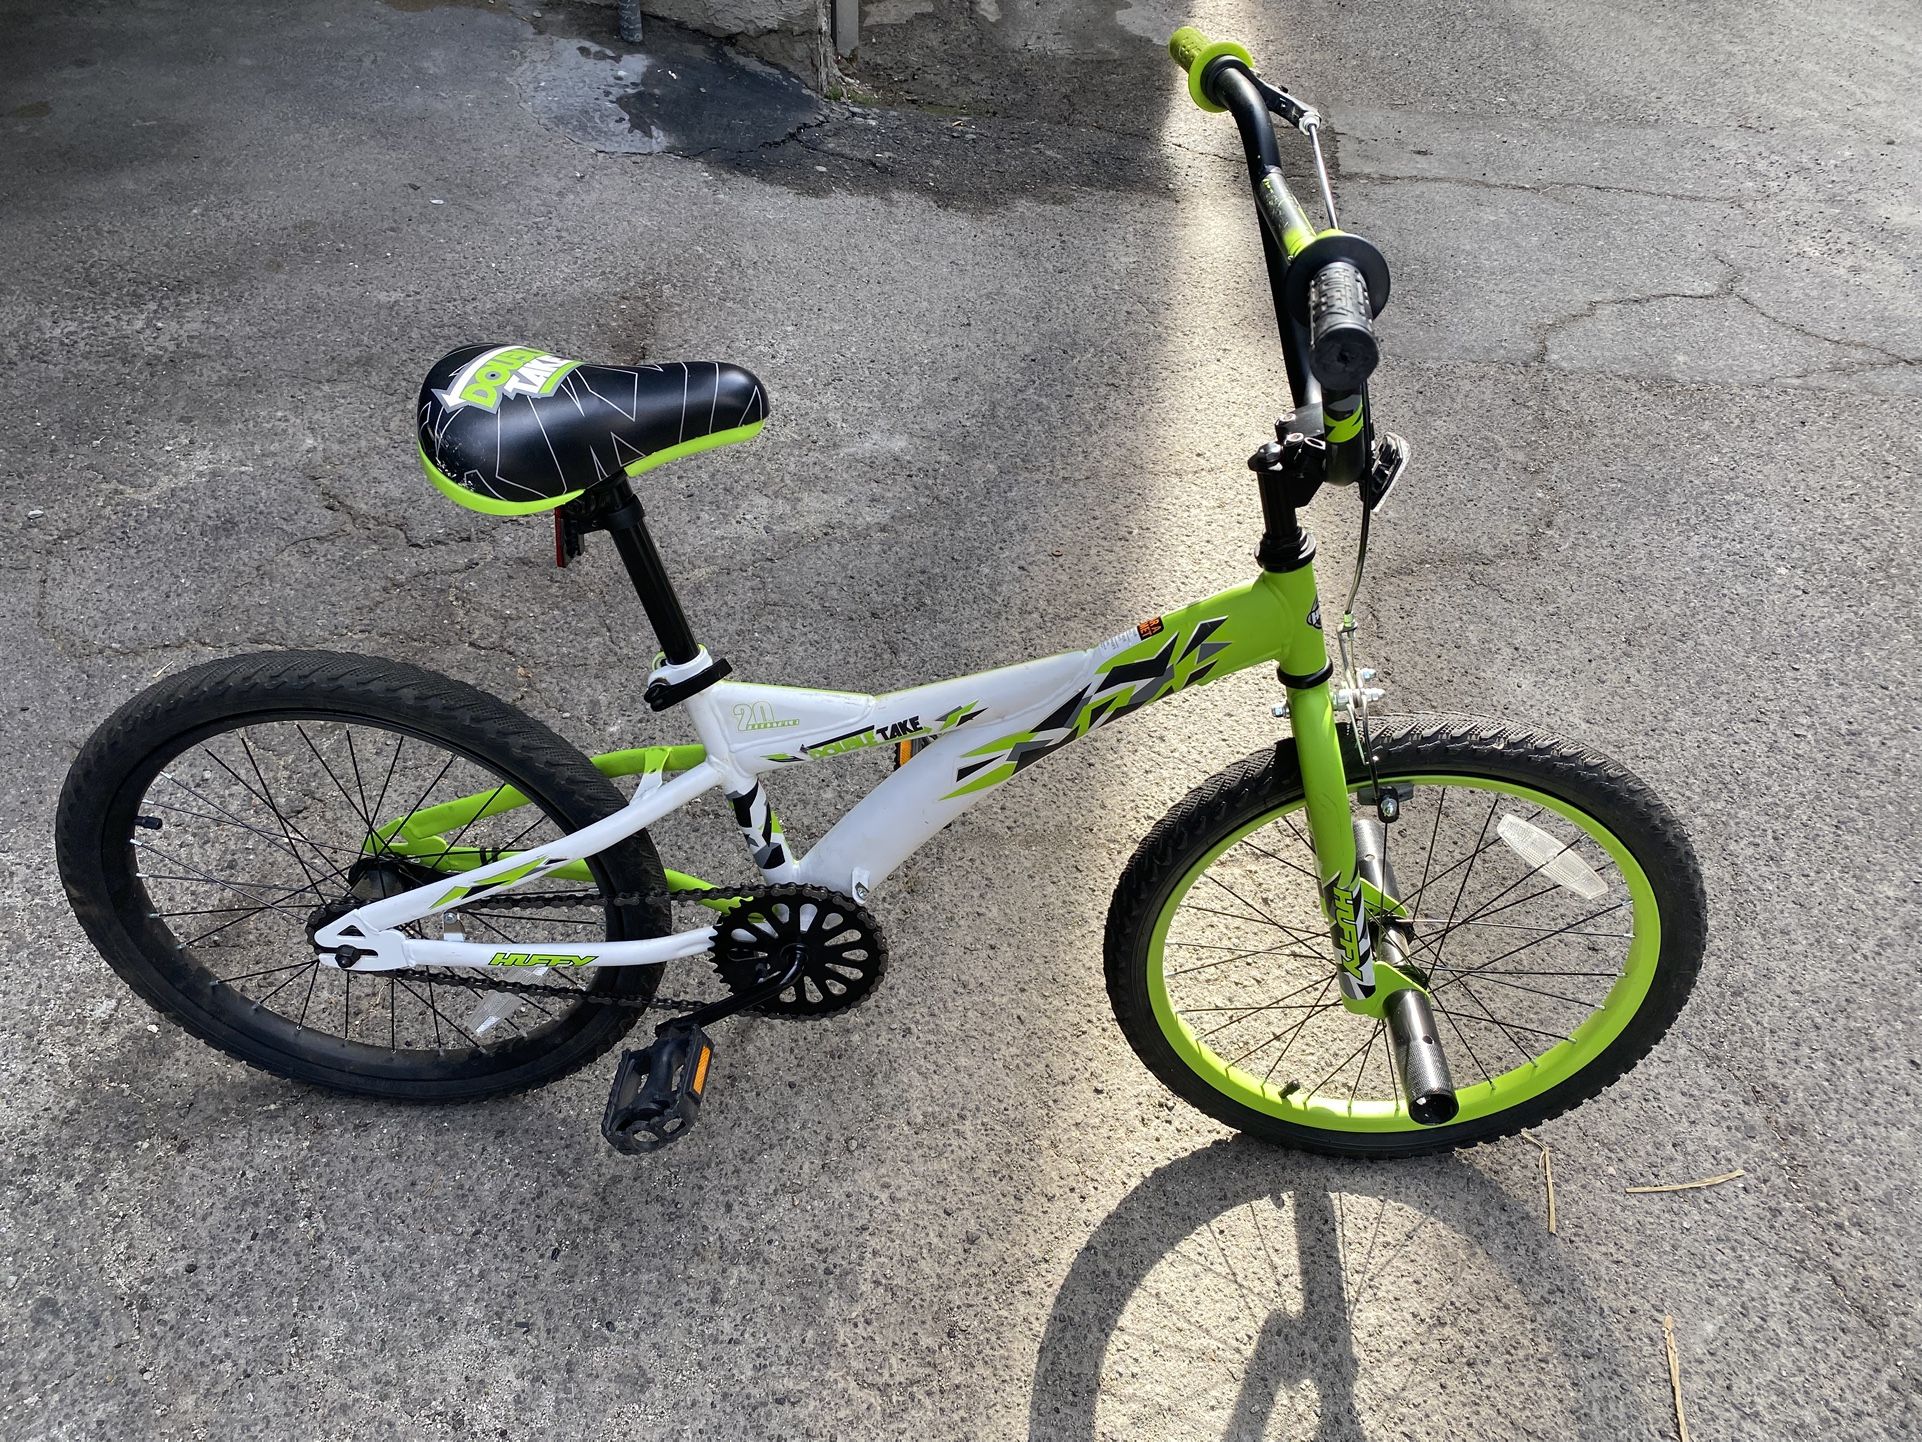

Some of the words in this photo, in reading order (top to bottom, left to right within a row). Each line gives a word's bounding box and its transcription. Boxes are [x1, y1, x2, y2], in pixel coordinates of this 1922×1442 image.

[732, 700, 776, 731] 20
[875, 715, 924, 741] TAKE
[1333, 886, 1364, 982] HUFFY
[488, 952, 600, 967] HUFFY
